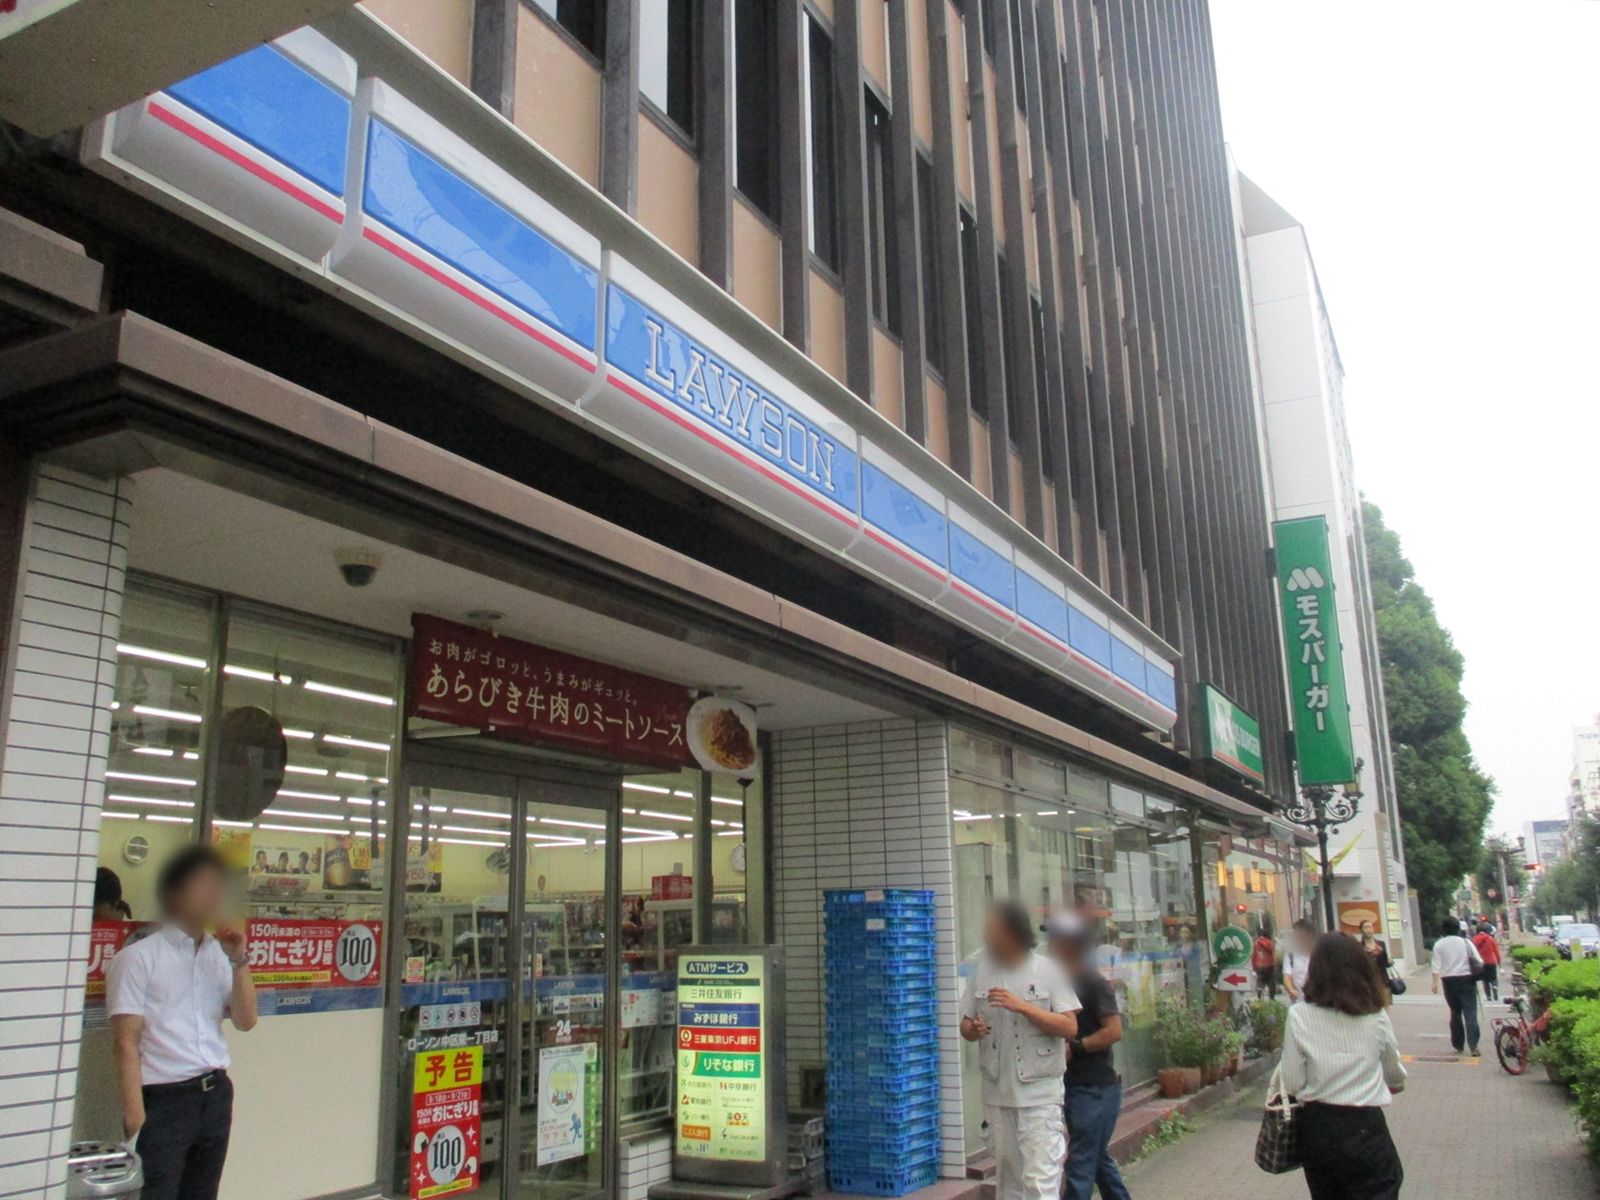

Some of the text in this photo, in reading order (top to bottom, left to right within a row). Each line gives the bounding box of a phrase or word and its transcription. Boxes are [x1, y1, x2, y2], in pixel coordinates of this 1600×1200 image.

[645, 316, 836, 492] LAWSON
[1296, 594, 1330, 731] モスバーガー
[426, 662, 683, 747] あらびき牛肉のミートソース
[341, 937, 372, 967] 100
[688, 962, 745, 973] ATMサービス
[691, 989, 742, 999] 三井住友銀行
[693, 1012, 738, 1025] みずほ銀行
[425, 1051, 474, 1087] 予告
[703, 1058, 755, 1072] りそな銀行
[431, 1137, 461, 1171] 100
